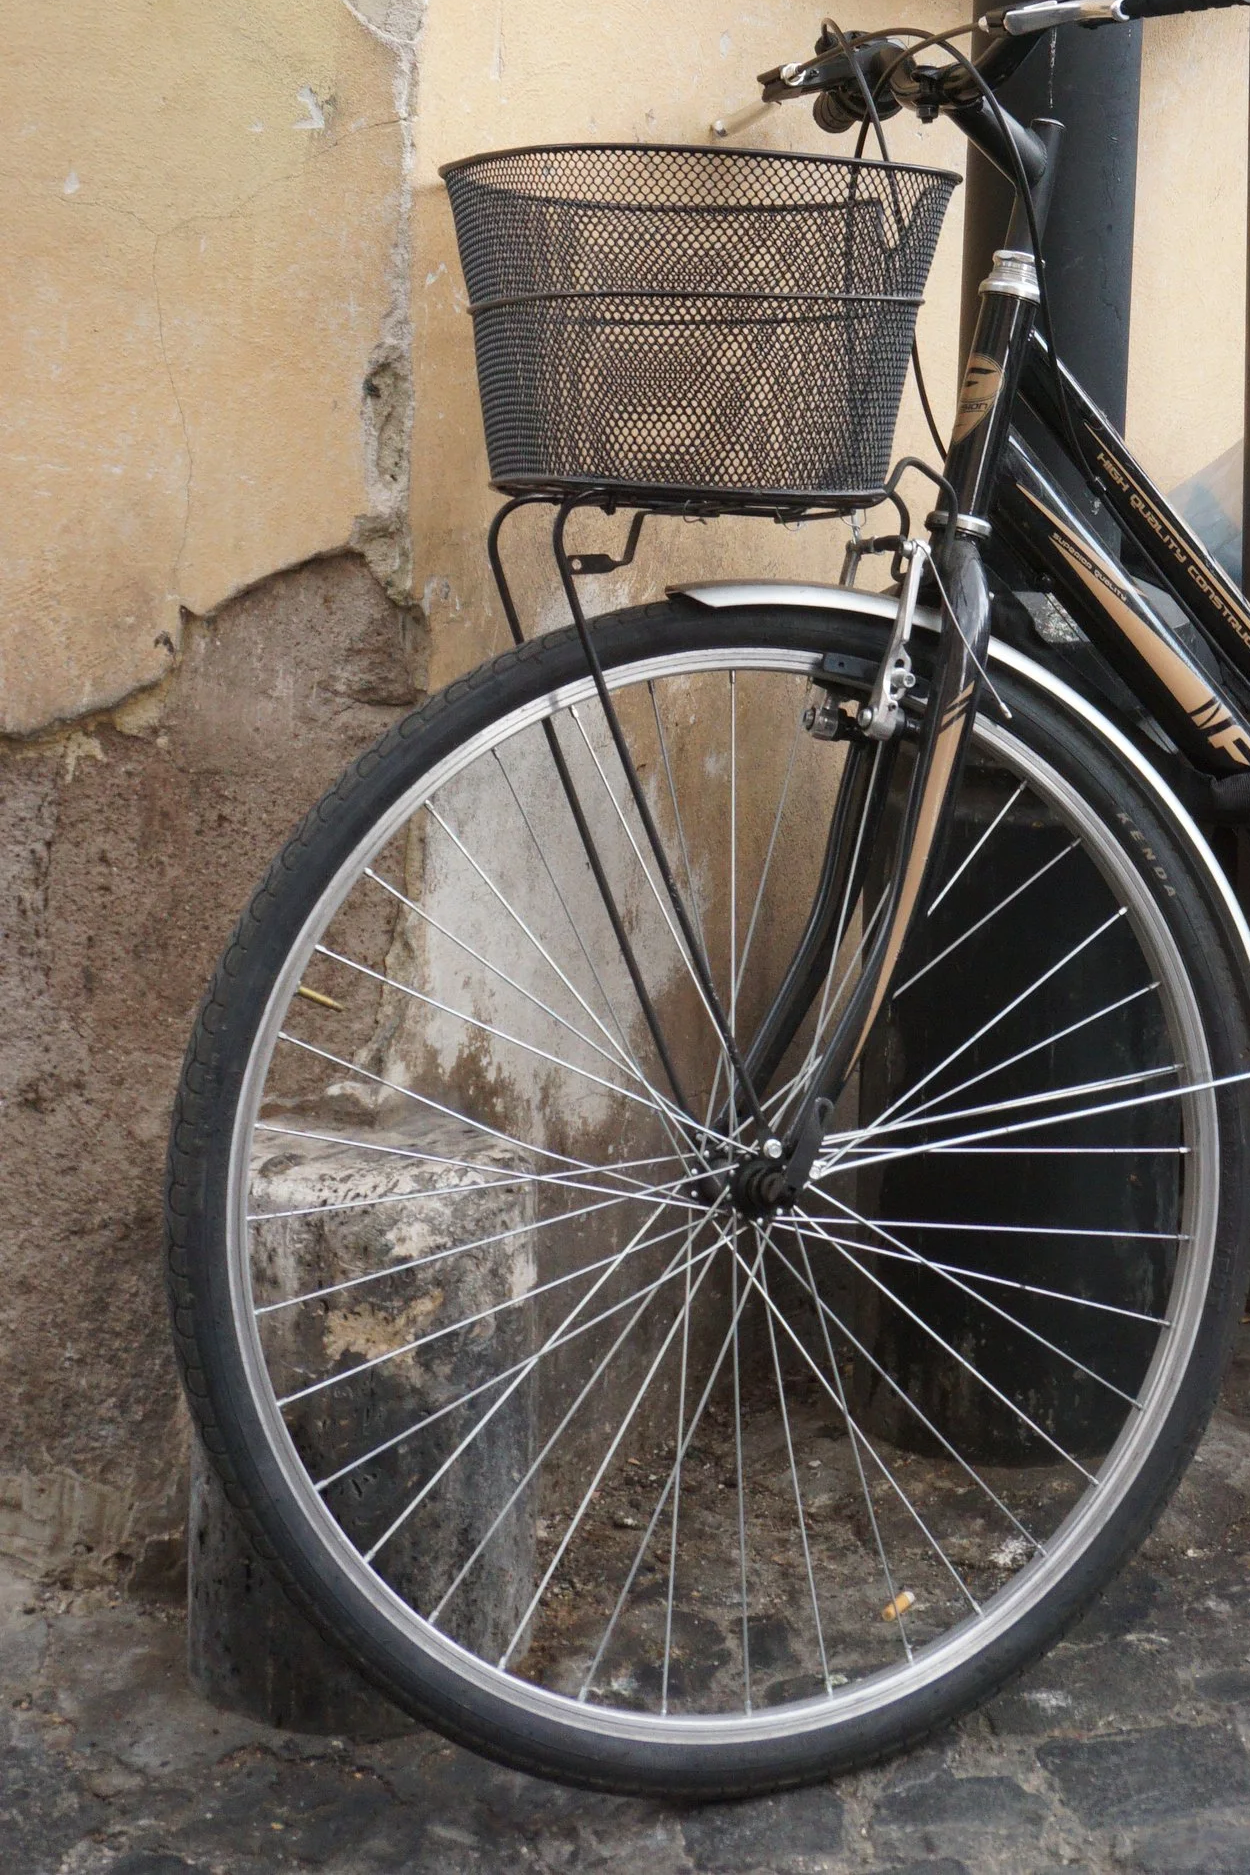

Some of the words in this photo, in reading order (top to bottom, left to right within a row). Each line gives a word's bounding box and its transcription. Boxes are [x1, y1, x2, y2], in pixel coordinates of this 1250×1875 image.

[1097, 453, 1130, 493] HIGH
[1130, 493, 1187, 564] QUALITY
[1116, 811, 1177, 898] KENDA
